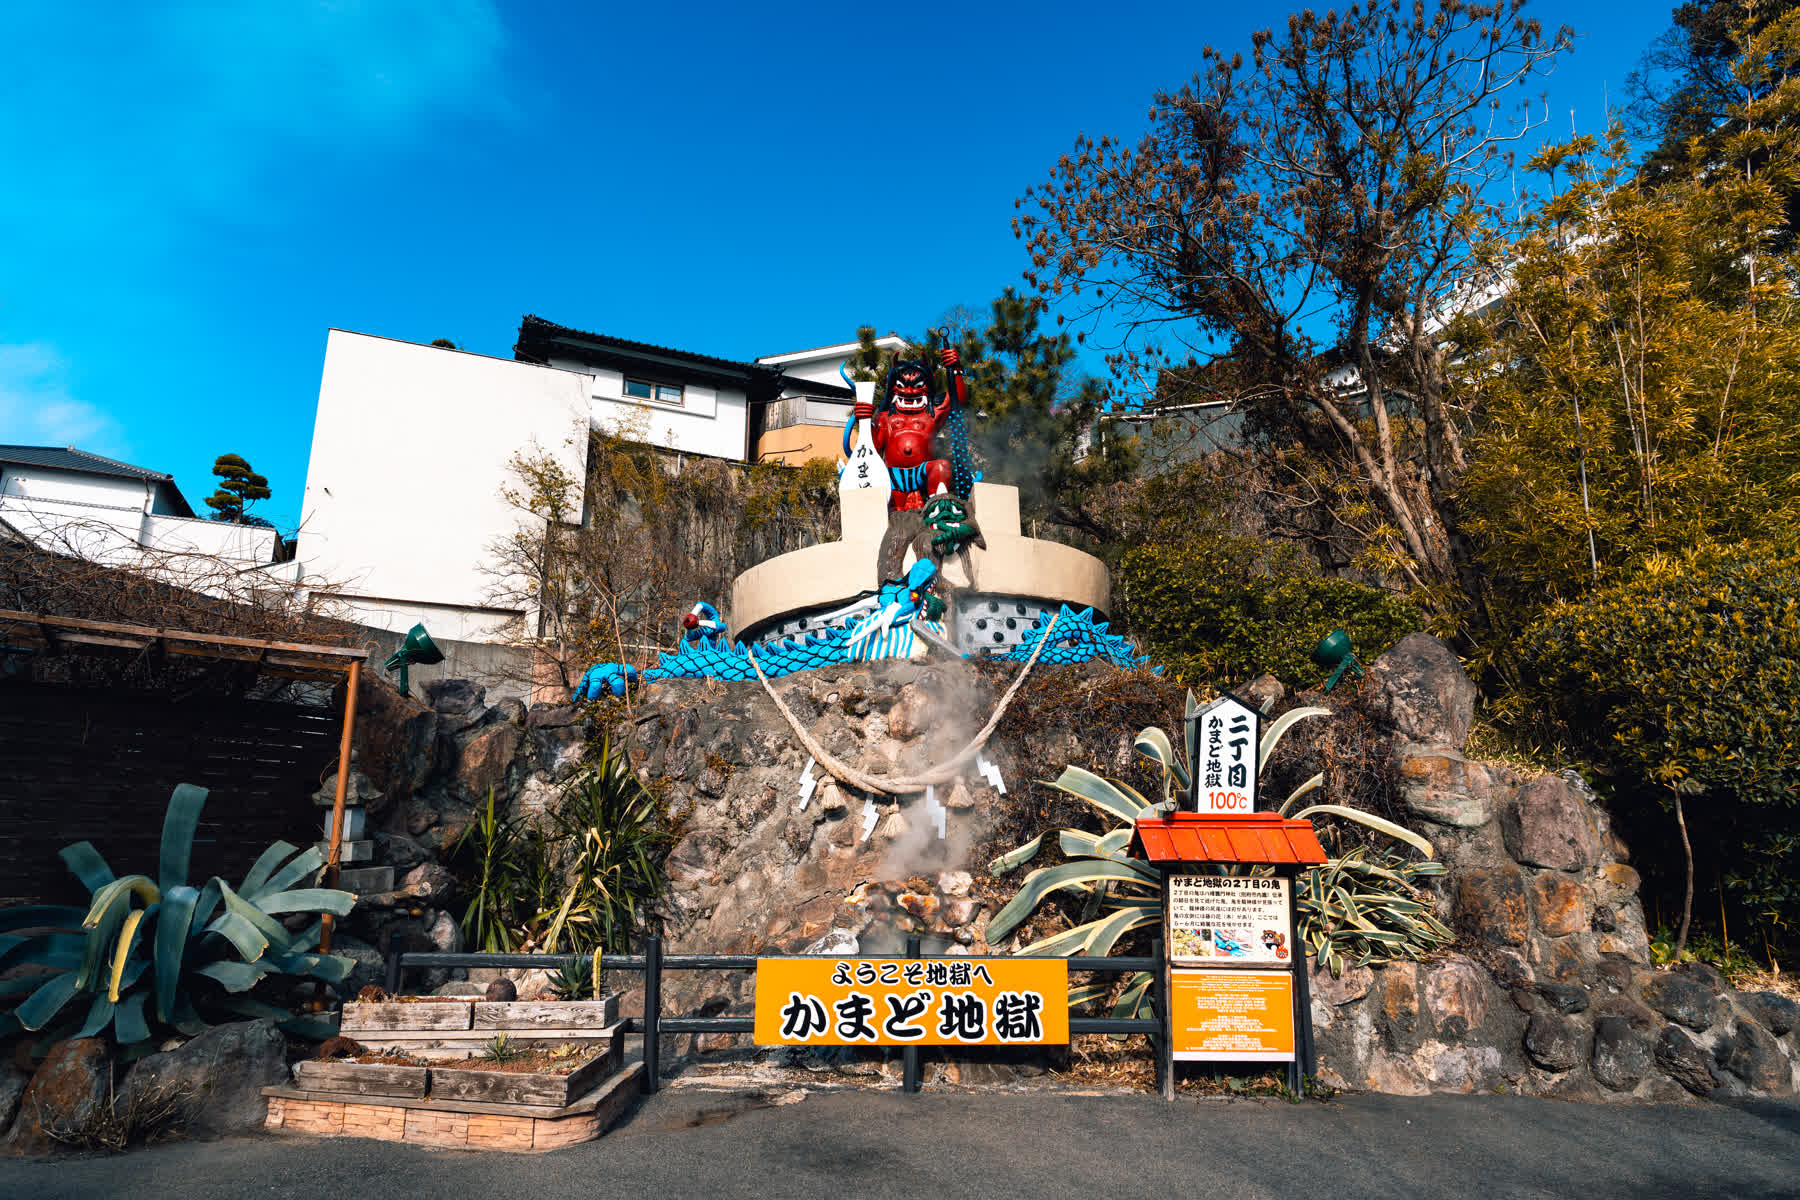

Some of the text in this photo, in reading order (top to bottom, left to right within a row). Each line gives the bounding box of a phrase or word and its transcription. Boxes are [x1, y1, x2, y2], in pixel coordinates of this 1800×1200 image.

[1204, 715, 1224, 788] かまど地獄
[1228, 714, 1250, 788] 二丁目
[832, 962, 993, 985] ようこそ地獄へ
[782, 992, 1042, 1039] かまど地獄
